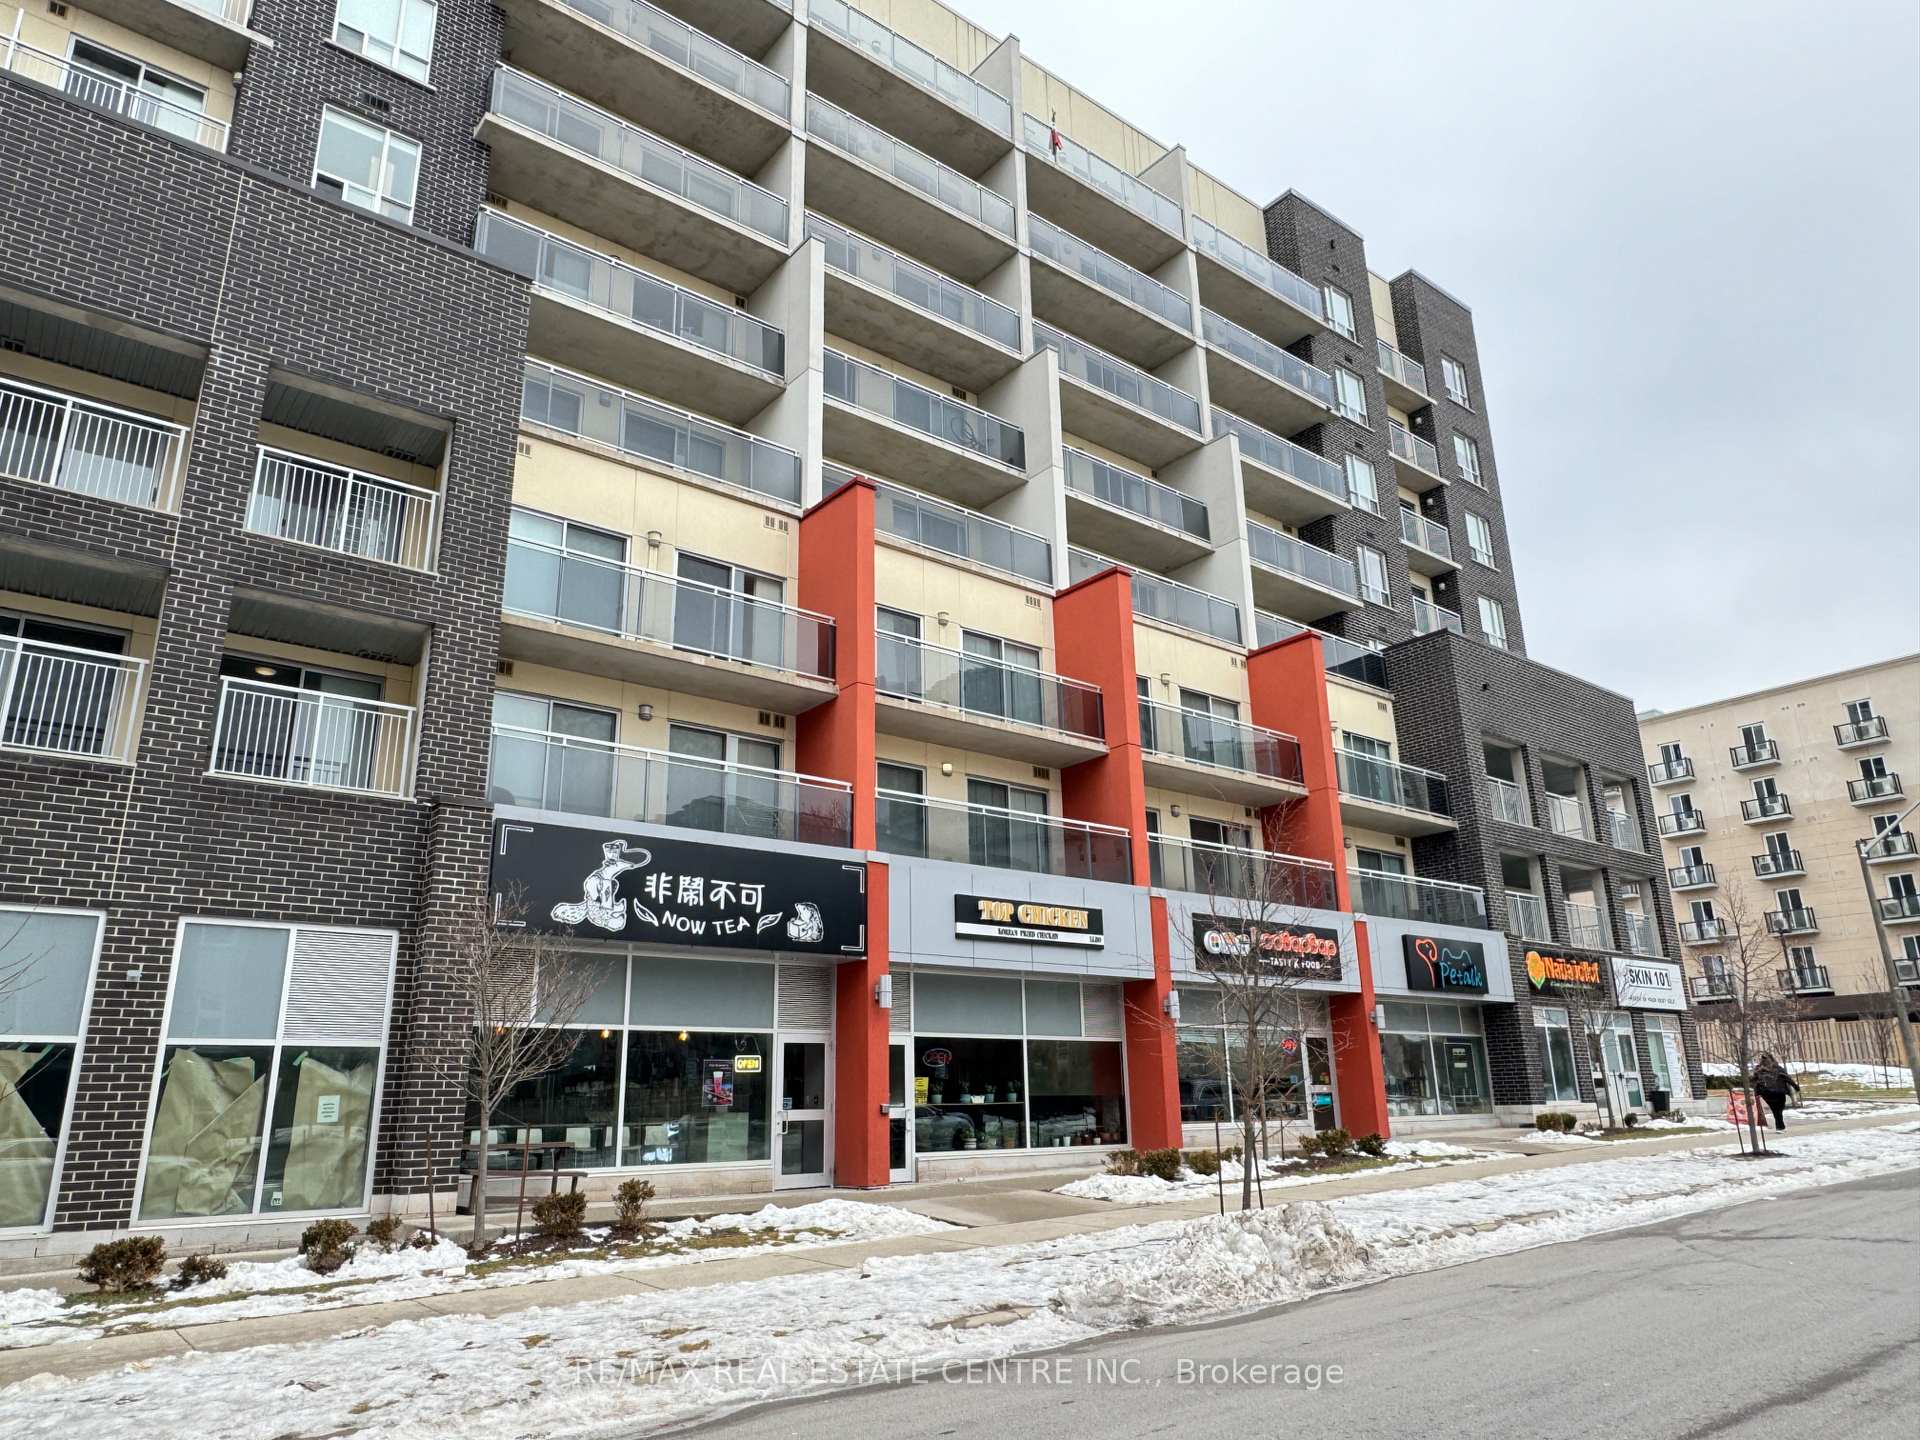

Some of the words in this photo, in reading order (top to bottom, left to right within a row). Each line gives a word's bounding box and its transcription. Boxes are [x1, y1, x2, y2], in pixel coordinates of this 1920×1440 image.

[644, 872, 766, 914] 非鬧不可
[662, 910, 706, 935] NOW
[711, 916, 751, 936] TEA
[978, 900, 1014, 922] TOP
[1018, 904, 1089, 929] CHICKEN
[1628, 968, 1652, 986] SKIN
[1654, 971, 1672, 988] 101
[737, 1058, 759, 1069] OPEN
